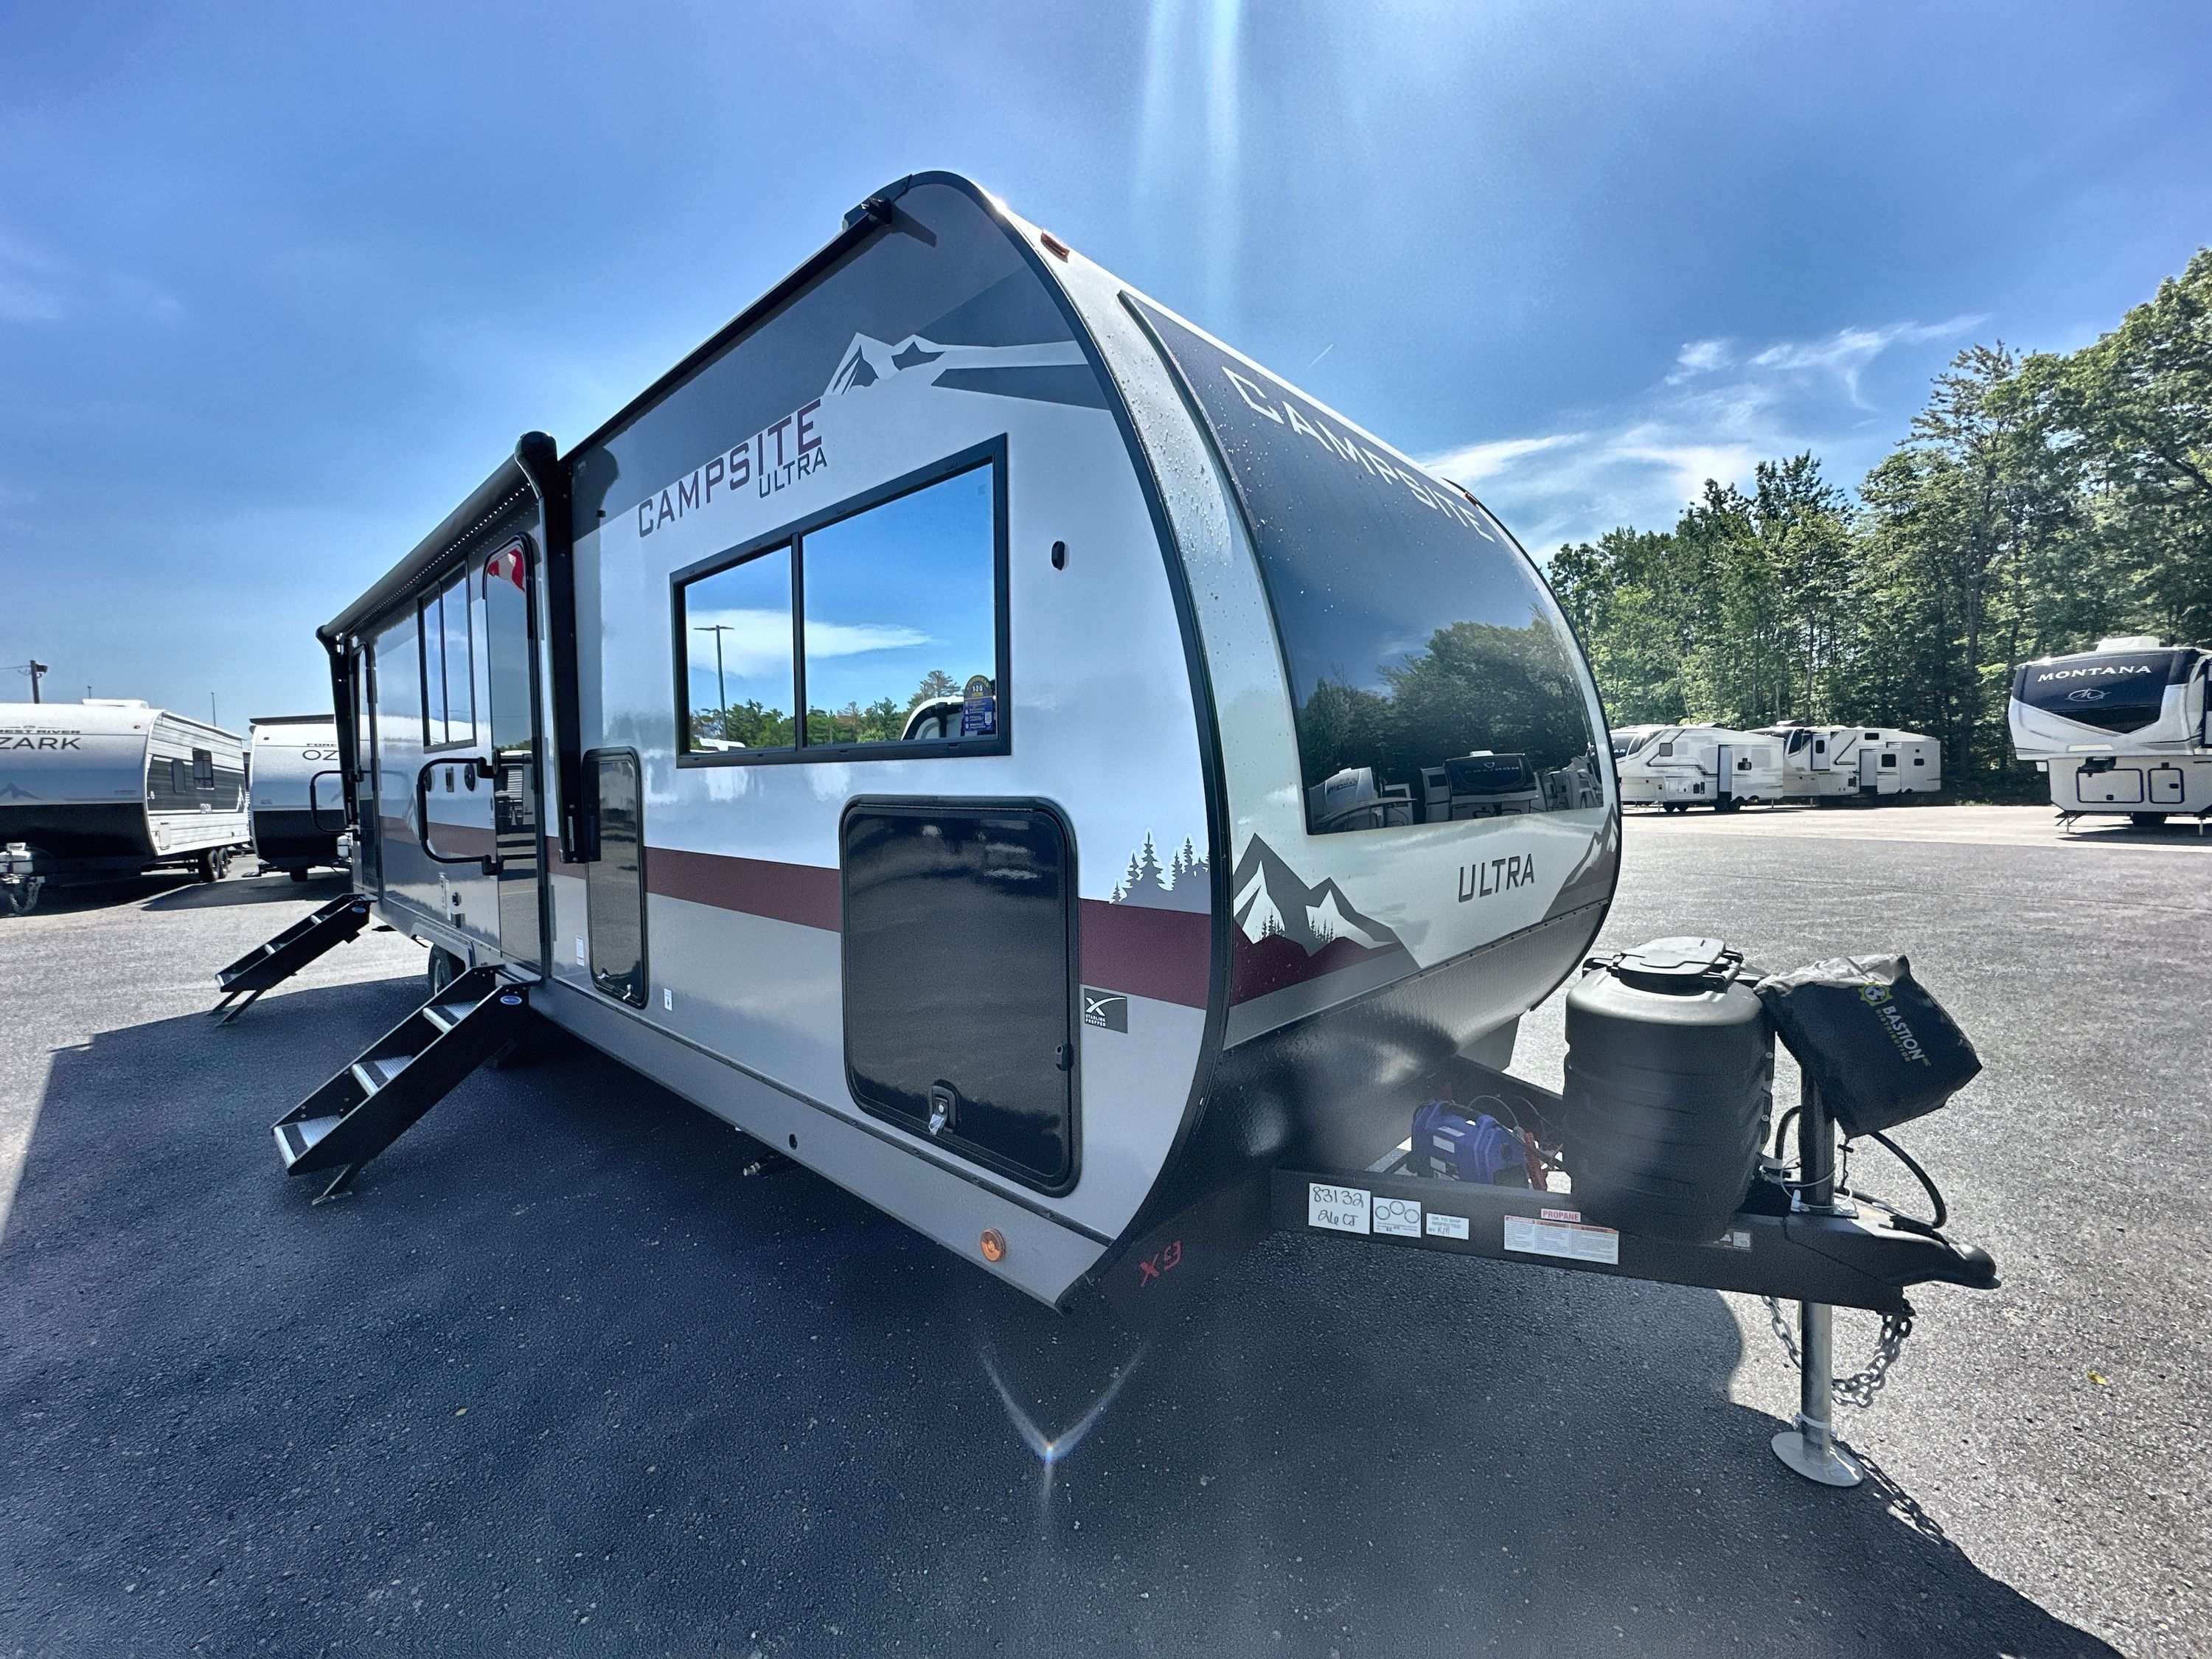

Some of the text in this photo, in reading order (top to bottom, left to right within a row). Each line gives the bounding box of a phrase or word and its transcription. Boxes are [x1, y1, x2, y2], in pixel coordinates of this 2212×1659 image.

[638, 398, 823, 538] CAMPSITE
[759, 446, 827, 498] ULTRA
[1221, 366, 1495, 543] CAMPSITE
[2037, 665, 2152, 683] MONTANA
[0, 737, 81, 750] ZARK
[1458, 853, 1535, 903] ULTRA
[1085, 1014, 1106, 1022] STARLINK
[1085, 1018, 1106, 1026] PREPPED
[1875, 1009, 1912, 1062] DISTRIBUTION
[1882, 1005, 1925, 1060] BASTION
[1312, 1186, 1364, 1208] 83132
[1543, 1210, 1579, 1221] PROPANE
